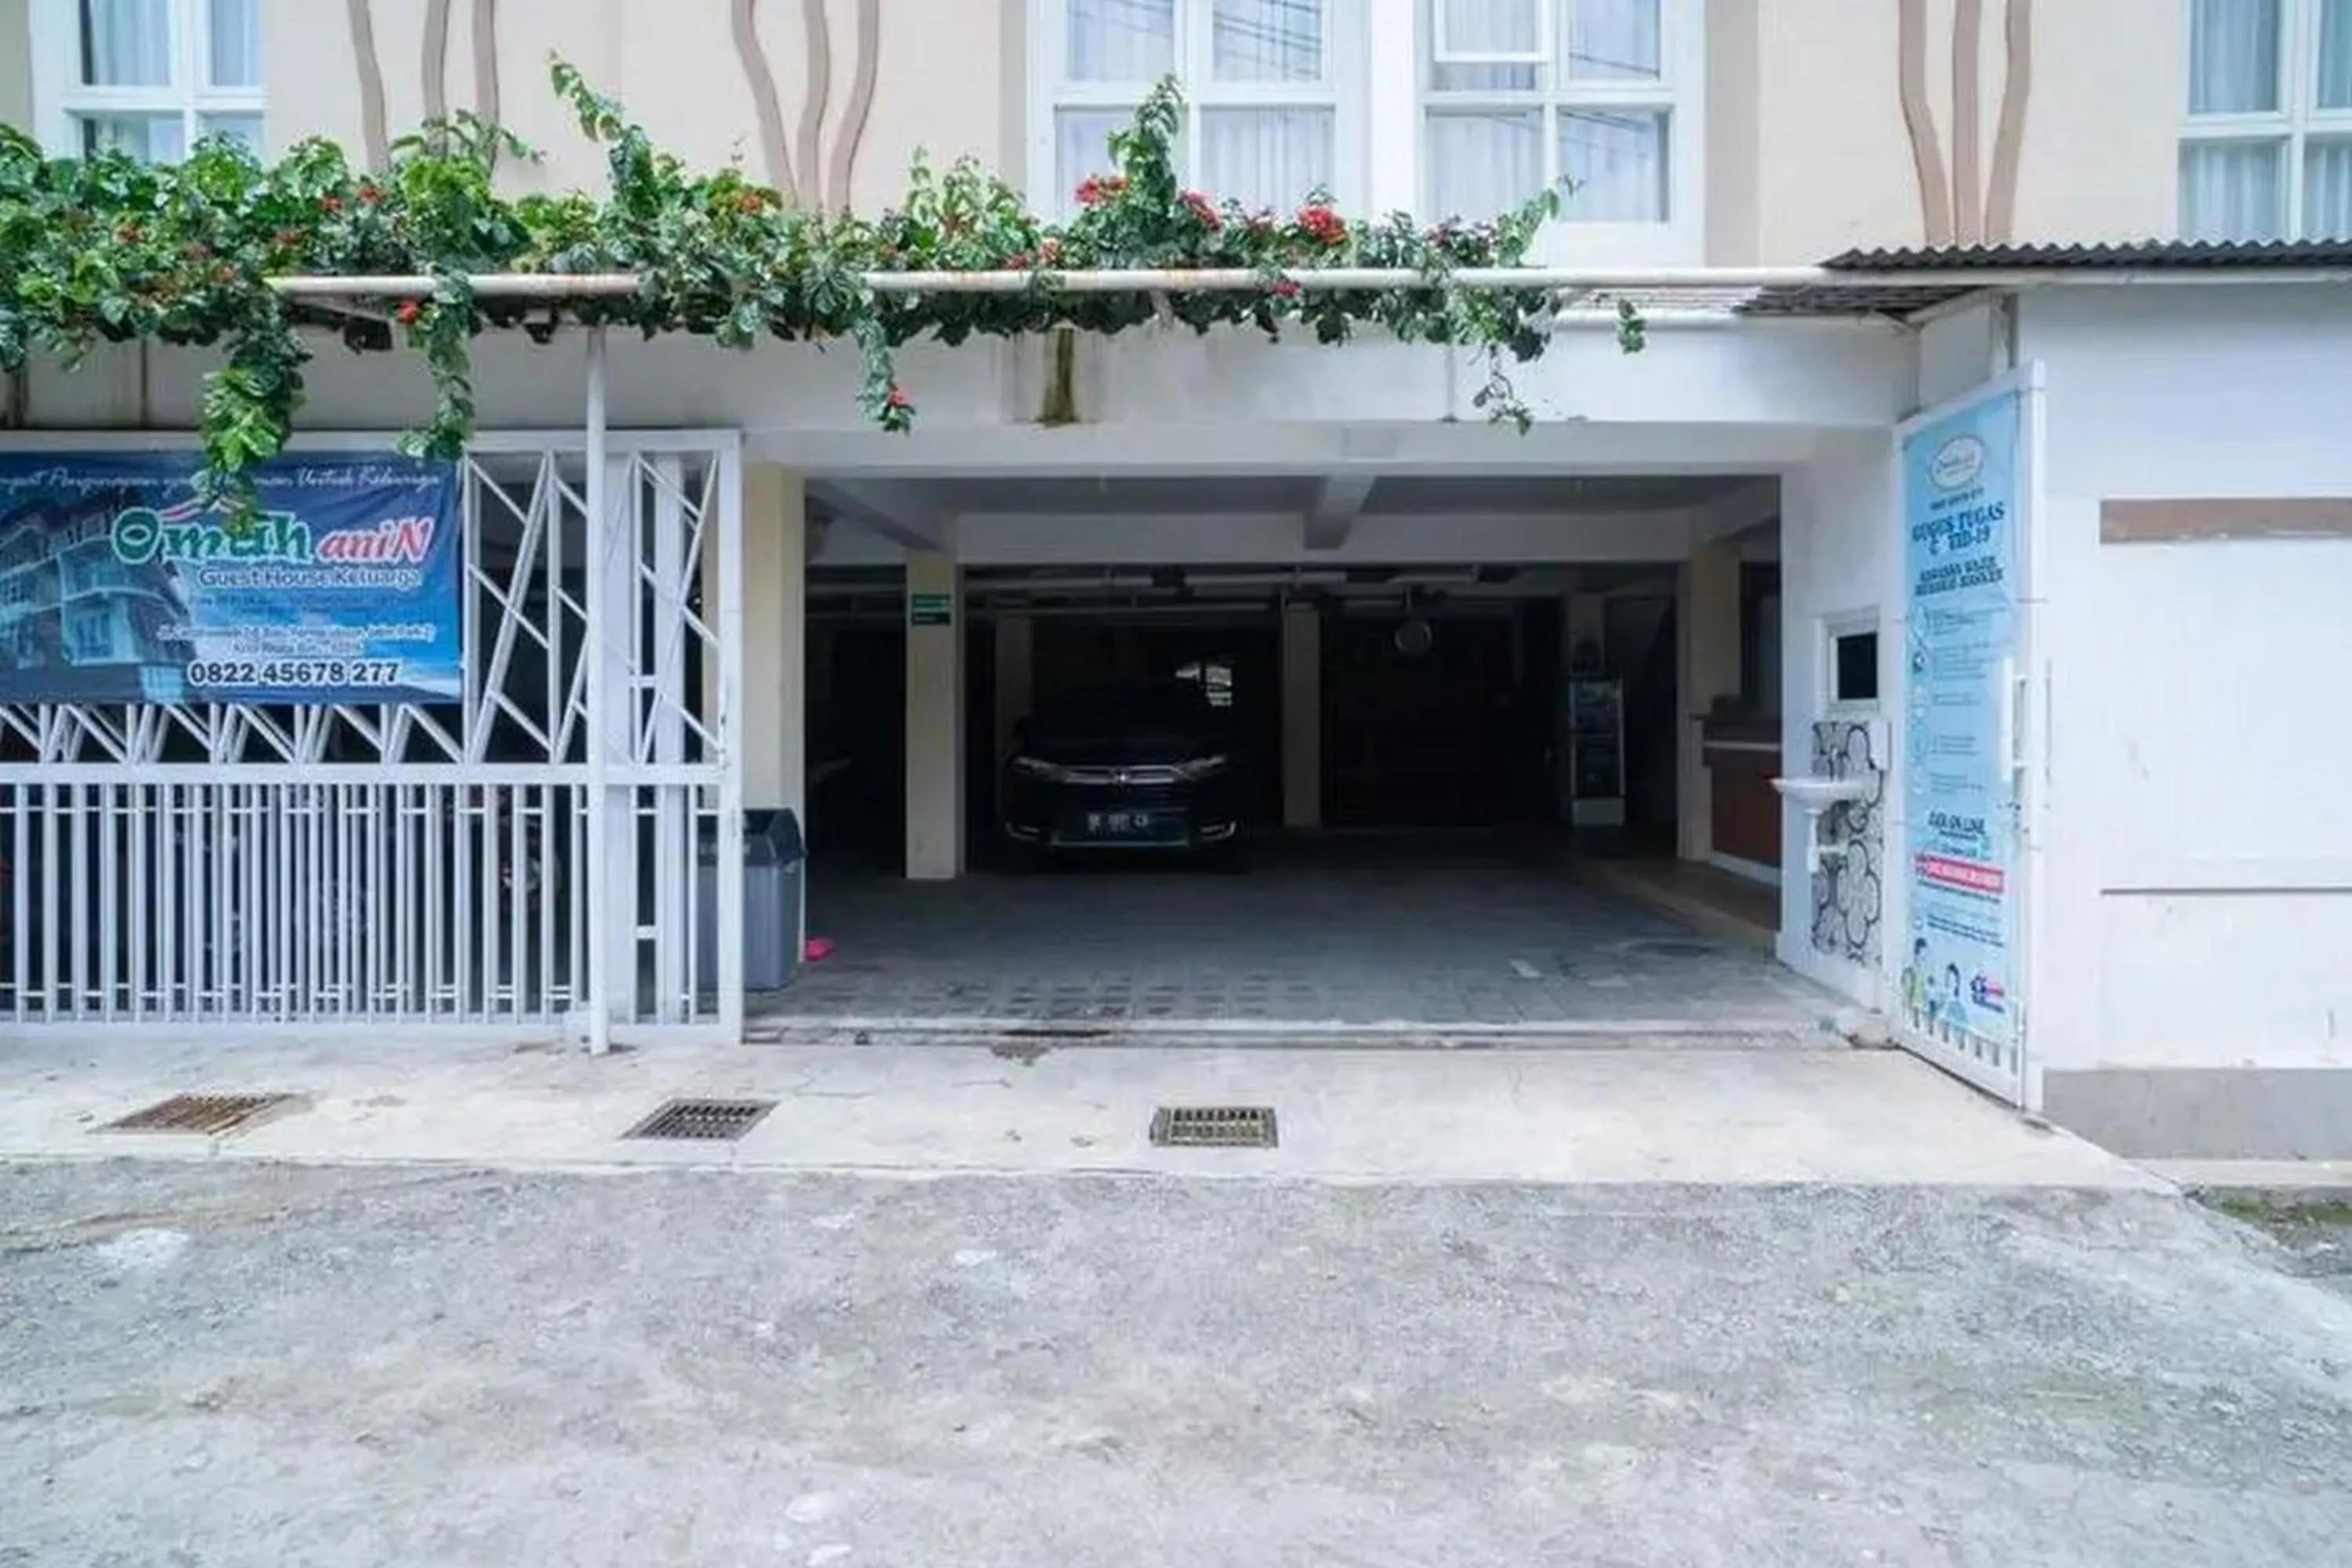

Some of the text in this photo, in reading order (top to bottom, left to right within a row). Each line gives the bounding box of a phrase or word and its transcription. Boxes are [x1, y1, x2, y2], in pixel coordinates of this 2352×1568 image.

[198, 566, 424, 591] Guest House Keluarga
[189, 661, 402, 685] 0822 45678 277
